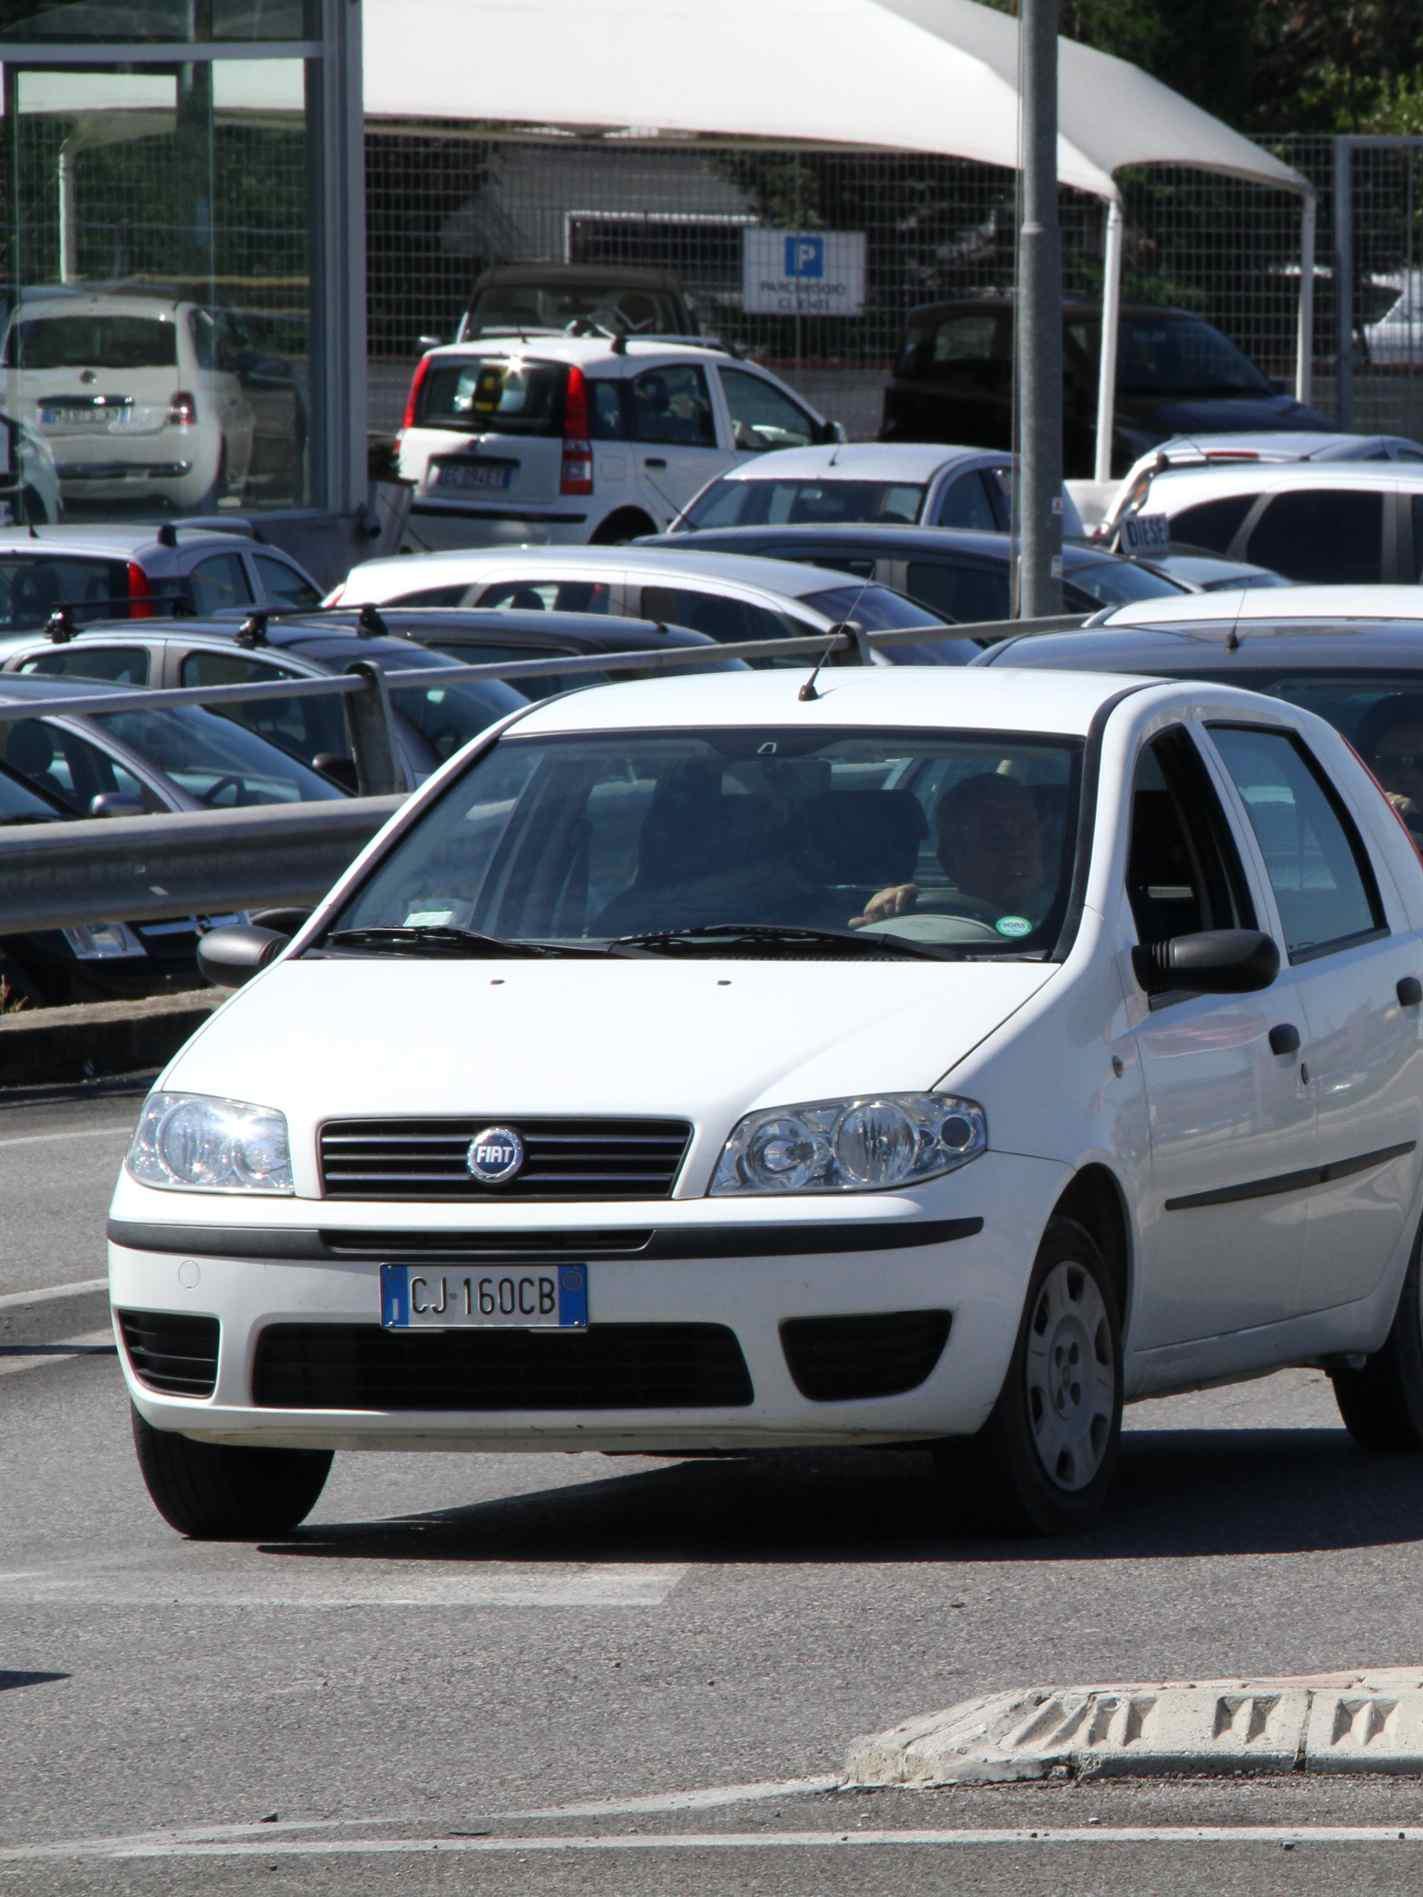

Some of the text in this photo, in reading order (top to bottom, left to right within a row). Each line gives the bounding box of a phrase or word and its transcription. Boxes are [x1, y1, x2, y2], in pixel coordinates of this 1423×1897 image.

[797, 244, 817, 272] P
[1125, 516, 1168, 548] DIESE
[477, 1145, 513, 1163] FIAT
[410, 1276, 556, 1316] CJ 160CB
